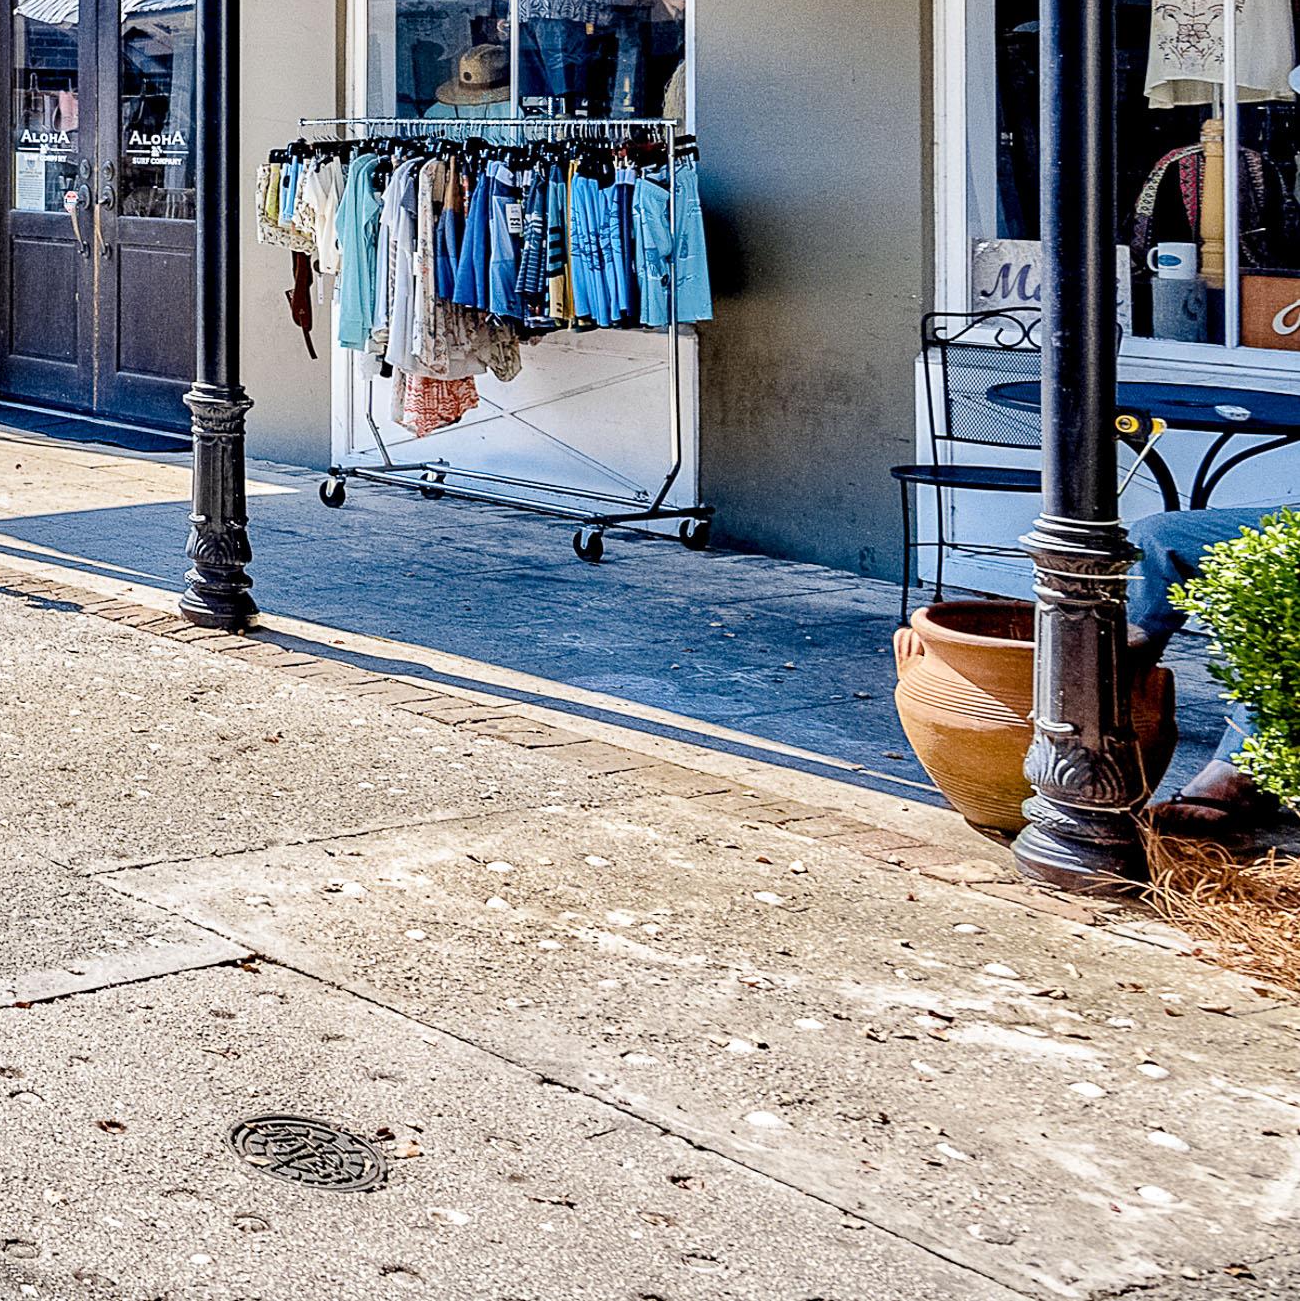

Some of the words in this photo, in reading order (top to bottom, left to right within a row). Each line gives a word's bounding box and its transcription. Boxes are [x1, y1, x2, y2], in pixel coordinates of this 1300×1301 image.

[21, 129, 70, 144] ALOHA
[129, 131, 186, 146] ALOHA
[132, 157, 150, 165] SURF
[151, 157, 182, 166] COMPANY
